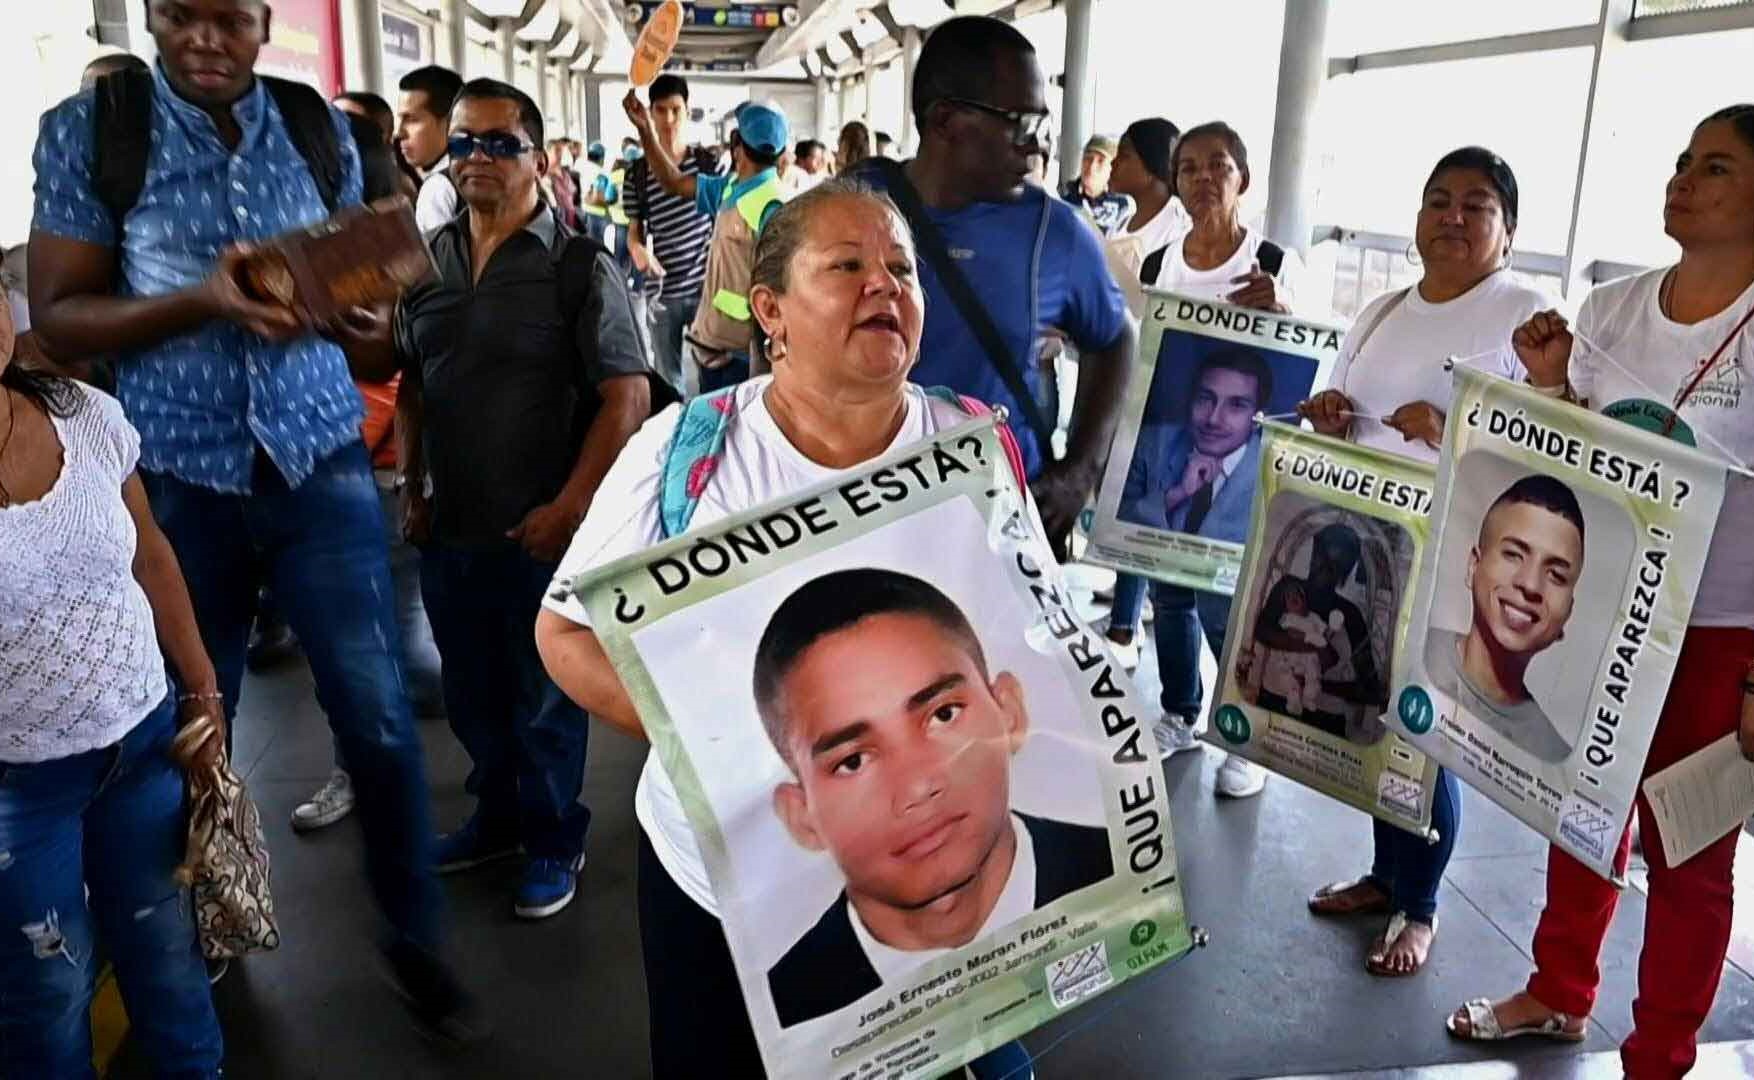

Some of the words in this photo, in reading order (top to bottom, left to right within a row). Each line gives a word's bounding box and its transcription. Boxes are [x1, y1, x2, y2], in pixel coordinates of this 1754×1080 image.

[1154, 302, 1167, 321] ¿
[1274, 451, 1287, 471] ¿
[1292, 454, 1375, 497] DÓNDE
[1467, 403, 1480, 426] ¿
[1488, 409, 1582, 466] DÓNDE
[1589, 449, 1661, 500] ESTÁ
[1672, 480, 1690, 507] ?
[613, 587, 645, 624] ¿
[1001, 509, 1148, 764] APAREZCA
[1585, 706, 1620, 769] QUE
[1604, 550, 1668, 704] APAREZCA
[1650, 526, 1671, 540] !
[1119, 776, 1164, 874] QUE
[858, 998, 896, 1027] José
[900, 967, 963, 1004] Ernesto
